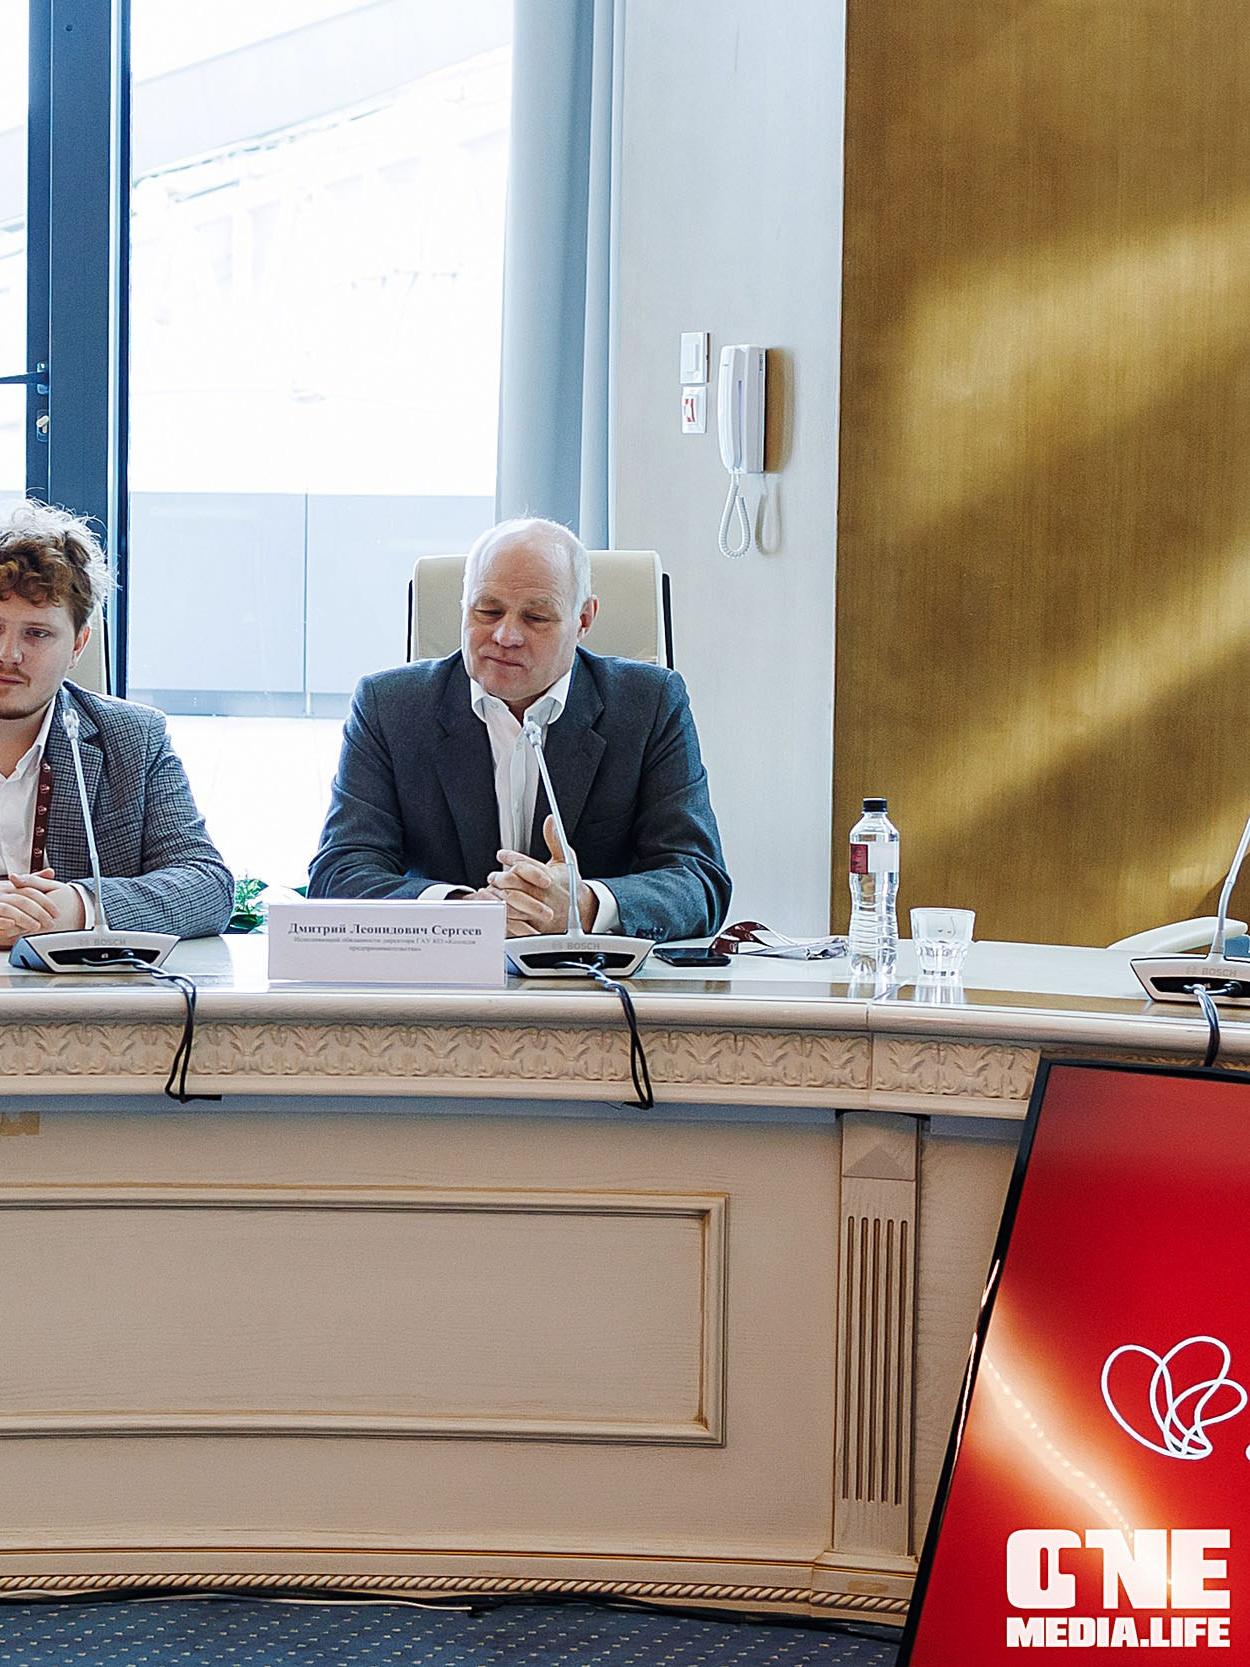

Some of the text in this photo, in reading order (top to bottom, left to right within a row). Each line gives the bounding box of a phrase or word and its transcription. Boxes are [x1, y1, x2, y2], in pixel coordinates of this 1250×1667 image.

[288, 923, 482, 937] Дмитрий Леонидович Сергеев
[567, 942, 600, 950] BOSCH
[1202, 967, 1237, 977] BOSCH
